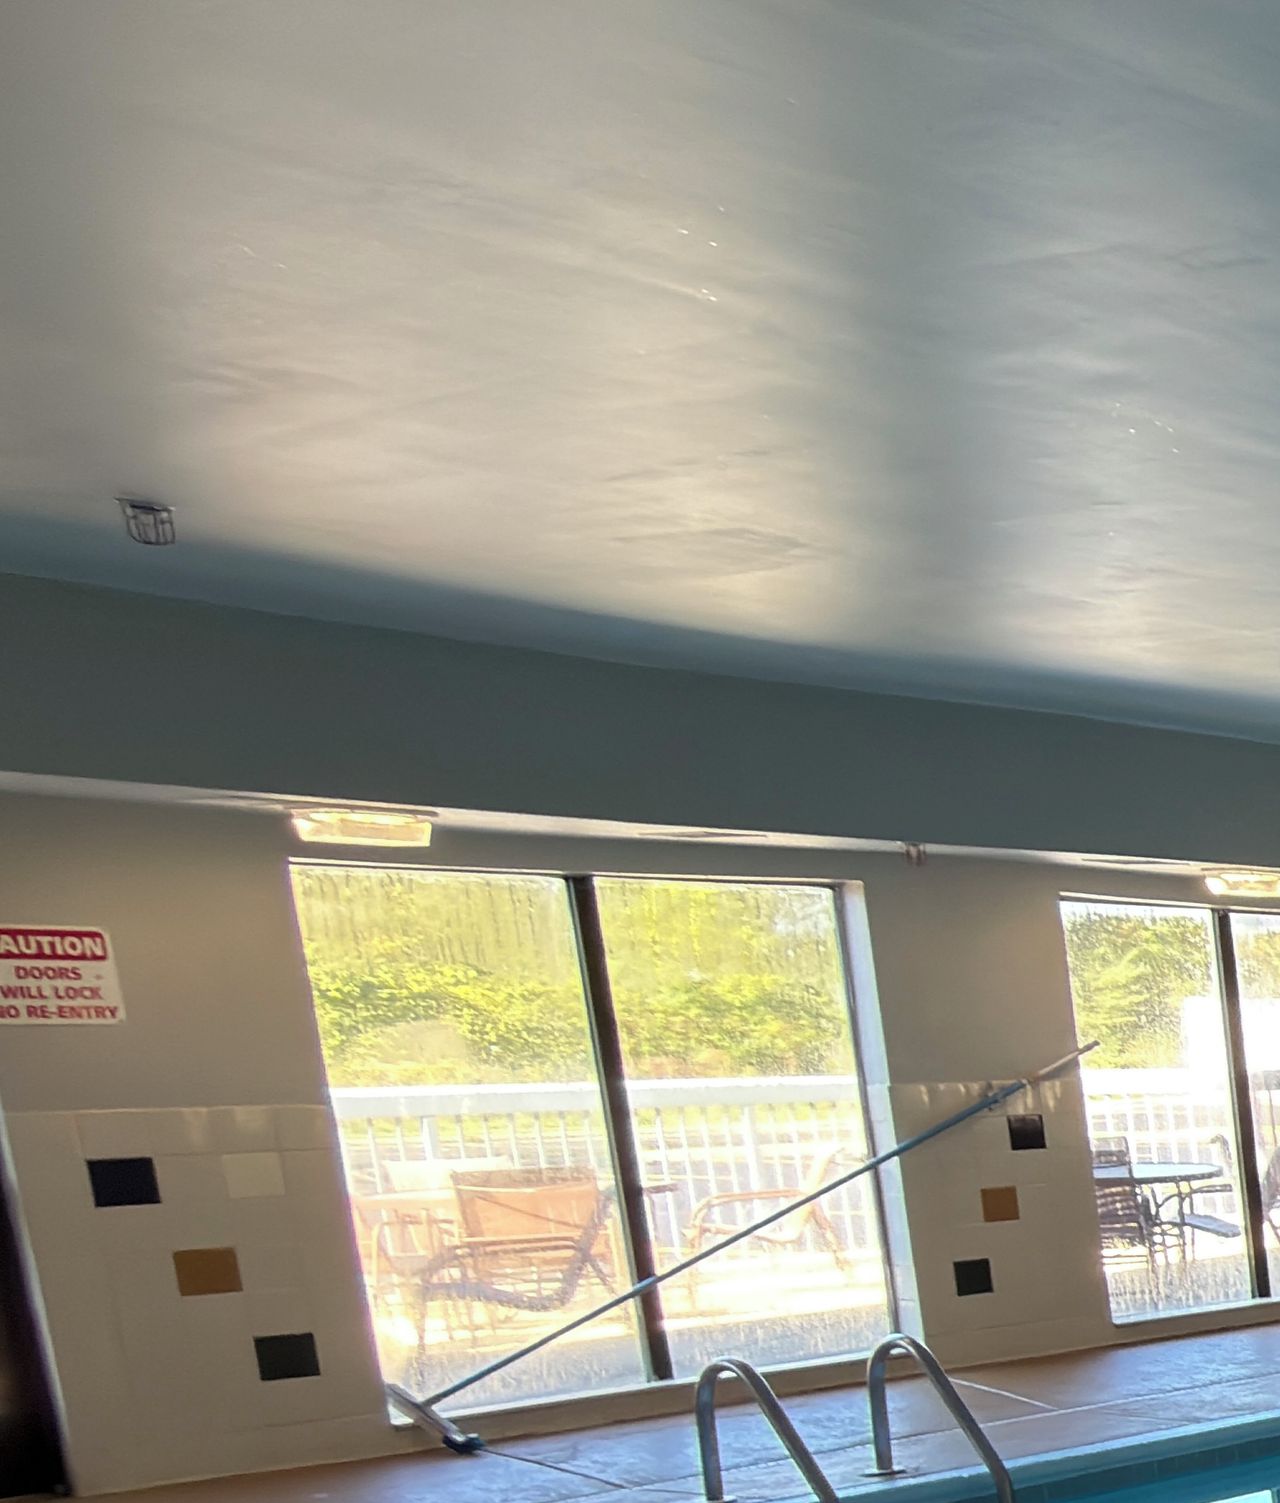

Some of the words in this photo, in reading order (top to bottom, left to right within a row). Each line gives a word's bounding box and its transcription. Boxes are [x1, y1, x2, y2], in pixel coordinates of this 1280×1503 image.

[0, 934, 105, 957] AUTION
[14, 966, 82, 980] DOORS
[0, 985, 48, 999] WILL
[54, 986, 103, 1000] LOCK
[26, 1005, 118, 1019] RE-ENTRY
